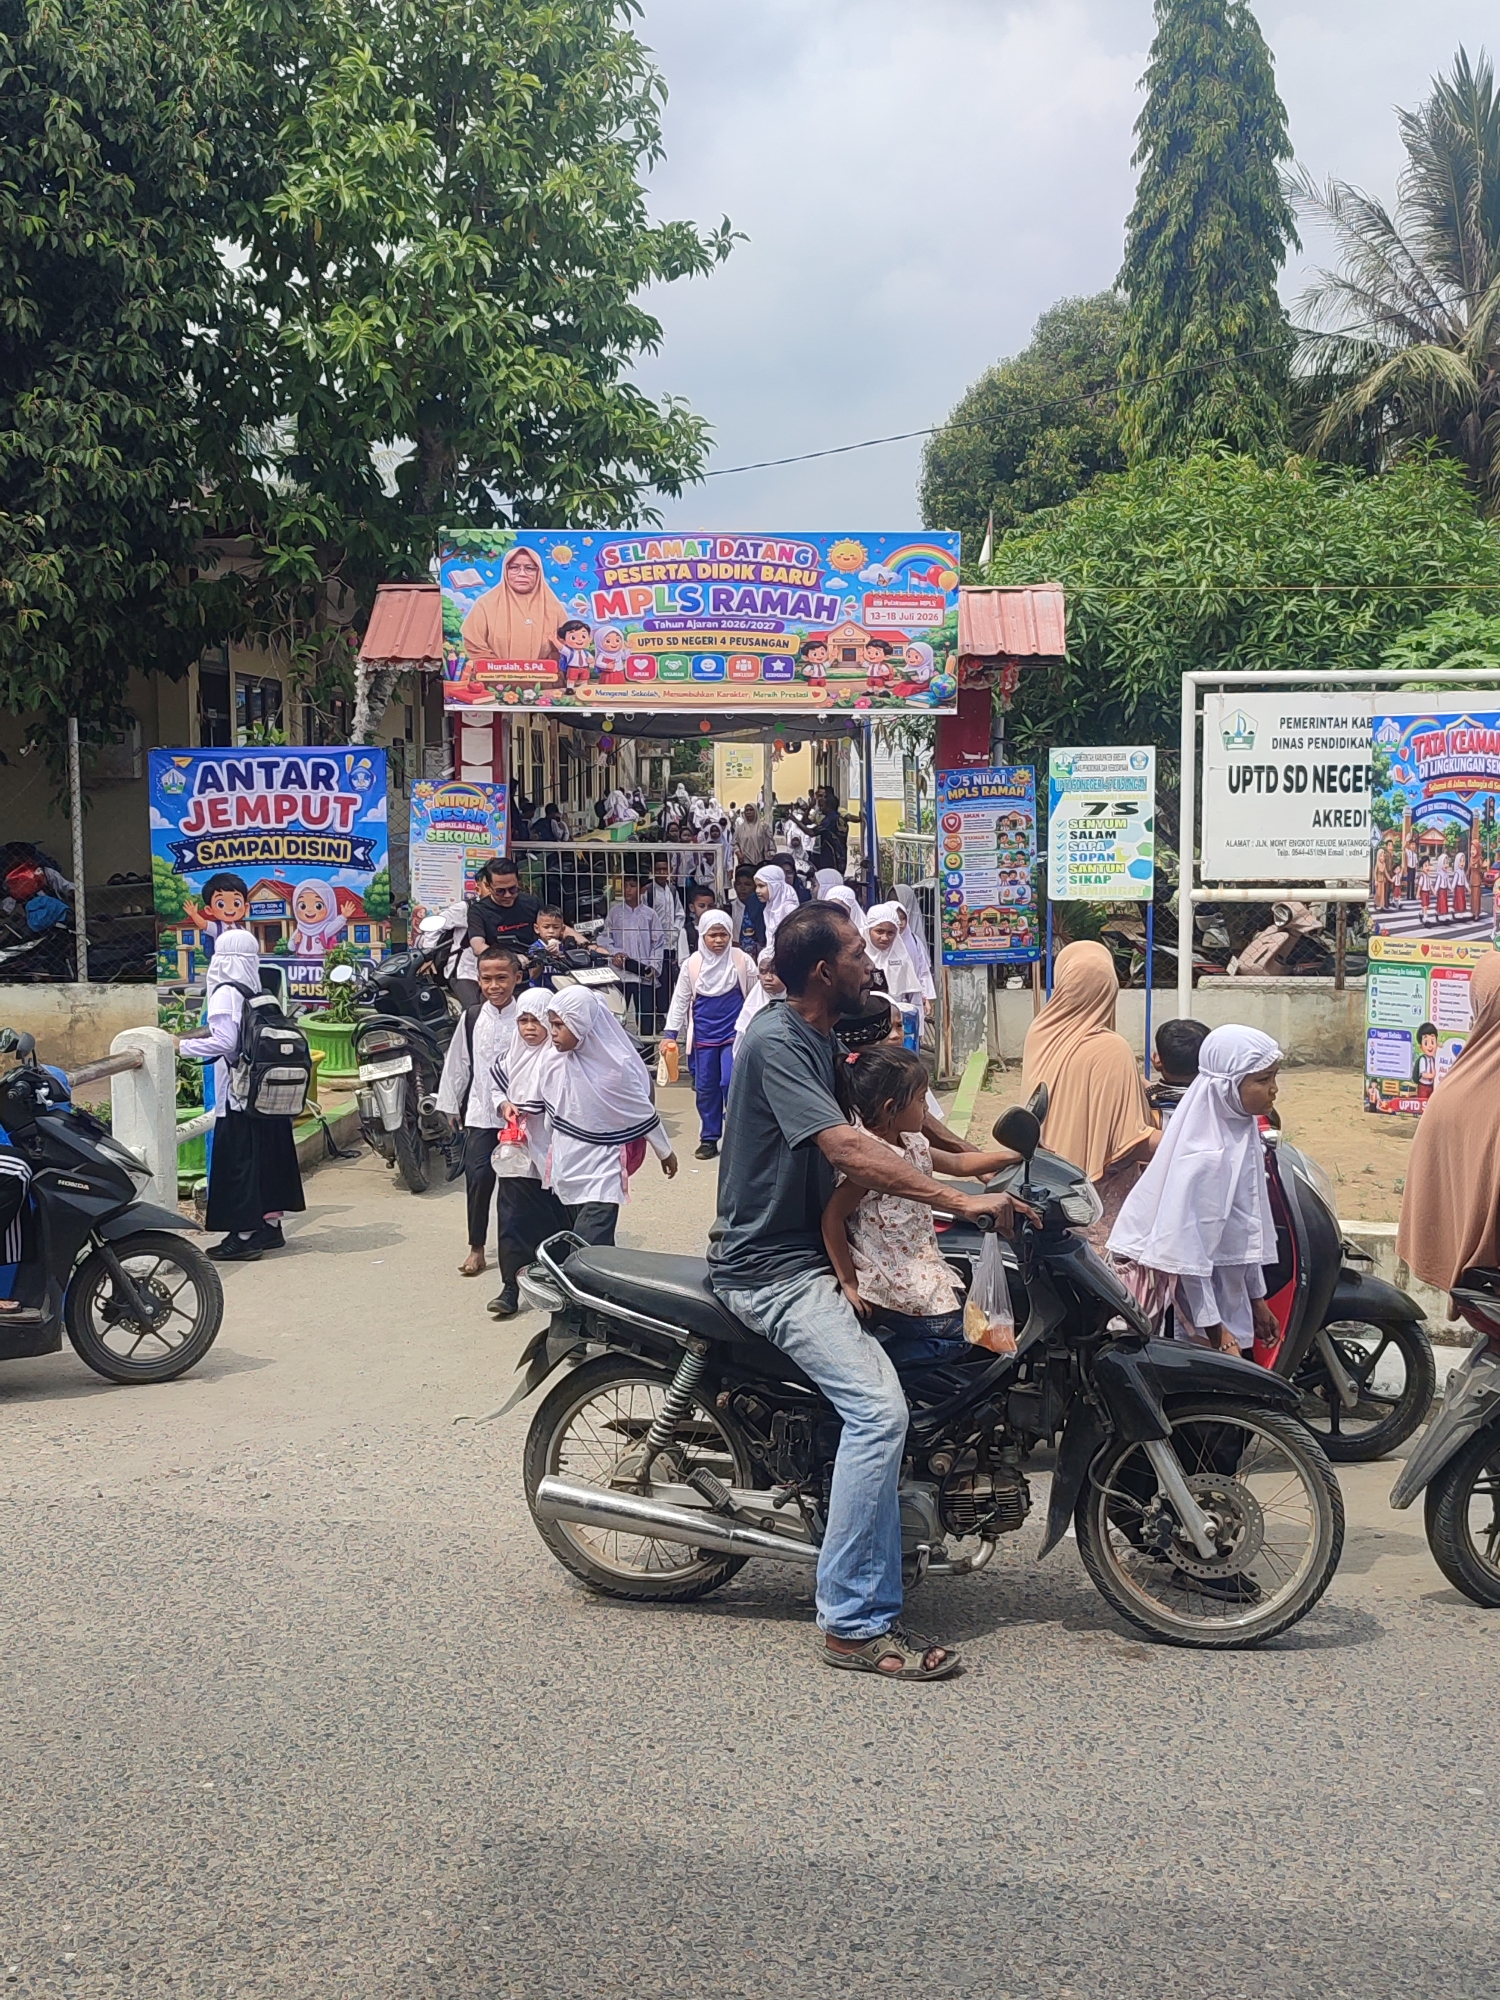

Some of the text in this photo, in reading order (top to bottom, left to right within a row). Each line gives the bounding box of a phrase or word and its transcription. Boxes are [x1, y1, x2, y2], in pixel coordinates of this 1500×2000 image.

[602, 540, 813, 566] SELAMAT DATANG
[604, 563, 818, 587] PESERTA DIDIK BARU
[593, 585, 839, 623] MPLS RAMAH
[899, 612, 914, 620] Juli
[916, 612, 939, 621] 2026
[653, 620, 776, 631] Tahun Ajaran 2026/2027
[637, 636, 790, 649] UPTD SD NEGERI 4 PEUSANGAN
[487, 662, 546, 671] Nursiah, S.Pd.
[595, 689, 629, 698] Mengenal
[662, 690, 715, 699] Menumbuhkan
[753, 690, 778, 698] Meraih
[780, 690, 809, 699] Prestasi
[1279, 717, 1348, 730] PEMERINTAH
[1271, 737, 1373, 750] DINAS PENDIDIKAN
[1412, 731, 1447, 764] TATA
[1419, 763, 1429, 779] DI
[1430, 758, 1485, 776] LINGKUNGAN
[197, 760, 337, 795] ANTAR
[962, 774, 1007, 787] 5 NILAI
[1227, 765, 1279, 794] UPTD
[1281, 765, 1308, 794] SD
[947, 785, 1026, 801] MPLS RAMAH
[434, 795, 485, 810] MIMPI
[1081, 801, 1140, 817] 7S
[183, 794, 358, 832] JEMPUT
[430, 807, 489, 826] BESAR
[1068, 818, 1128, 829] SENYUM
[426, 830, 491, 845] SEKOLAH
[1069, 830, 1117, 839] SALAM
[200, 838, 349, 861] SAMPAI DISINI
[1068, 841, 1107, 852] SAPA
[1225, 839, 1251, 848] ALAMAT
[1069, 853, 1116, 862] SOPAN
[1068, 863, 1126, 874] SANTUN
[1069, 875, 1112, 885] SIKAP
[1069, 886, 1144, 896] SEMANGAT
[287, 965, 325, 982] UPTD
[1399, 1101, 1420, 1110] UPTD
[57, 1179, 90, 1190] HONDA
